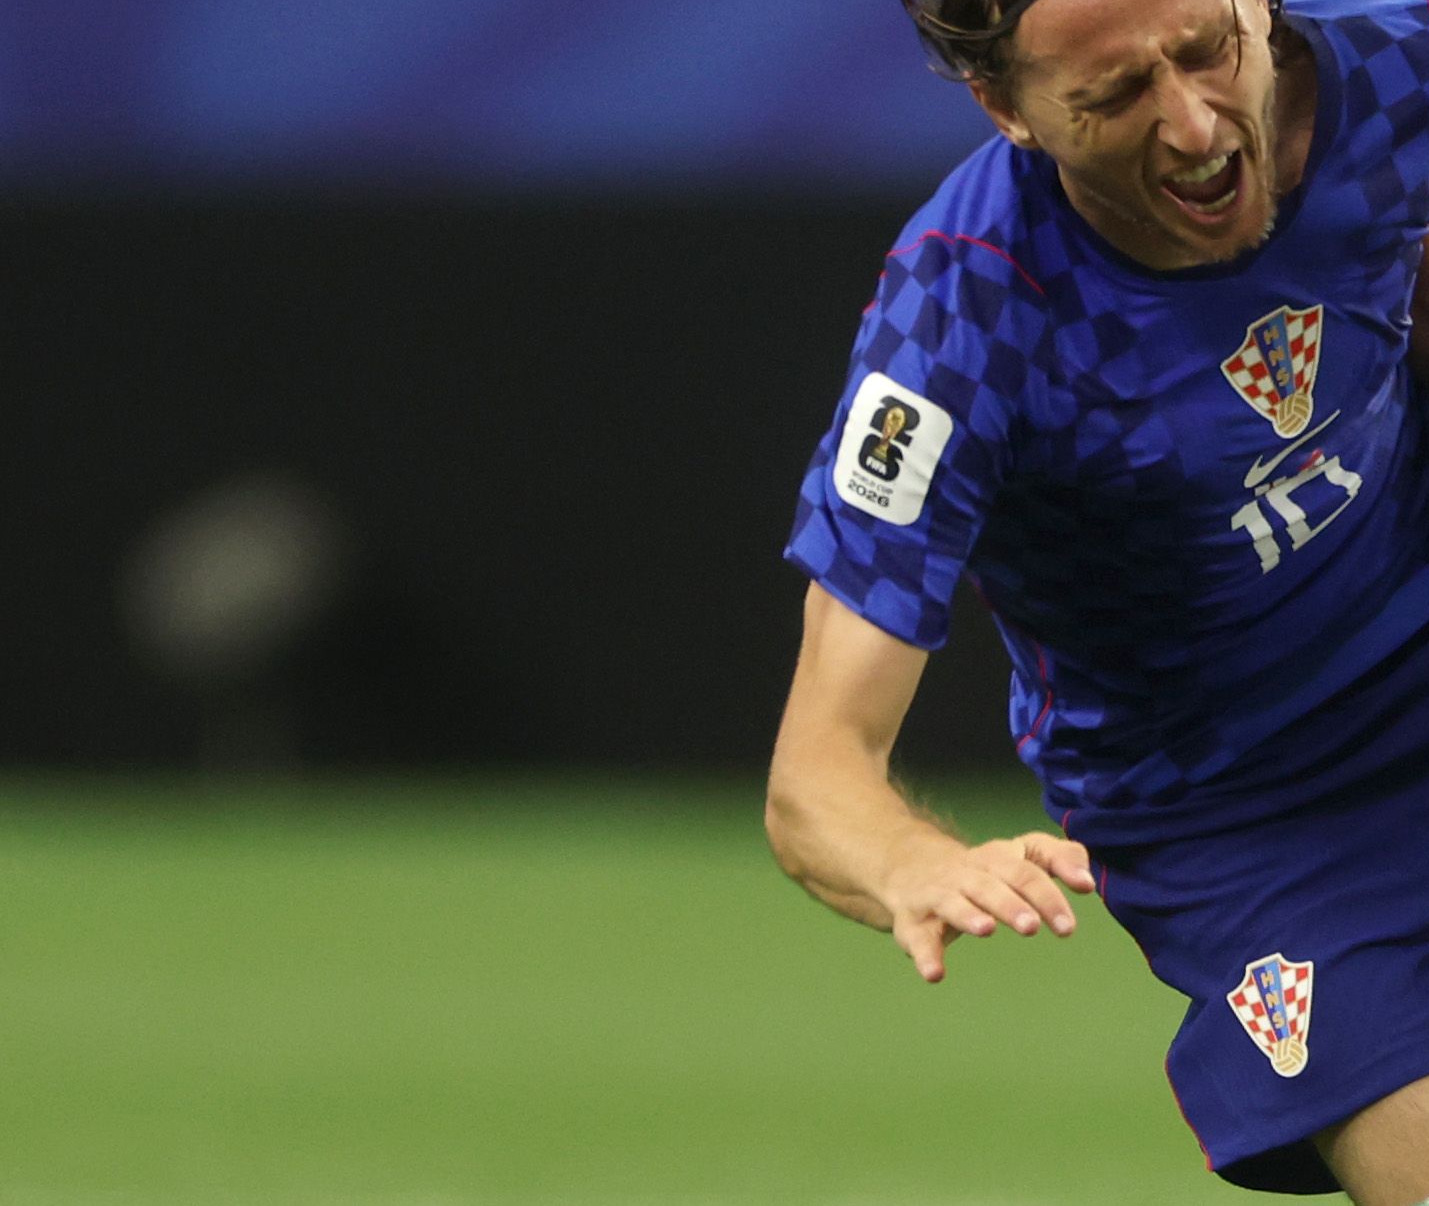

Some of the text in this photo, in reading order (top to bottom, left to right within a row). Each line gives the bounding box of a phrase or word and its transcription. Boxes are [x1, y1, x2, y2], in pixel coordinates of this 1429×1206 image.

[1263, 325, 1291, 387] HNS
[848, 479, 890, 508] 2026
[1231, 455, 1363, 575] 10
[1260, 970, 1285, 1029] HNS
